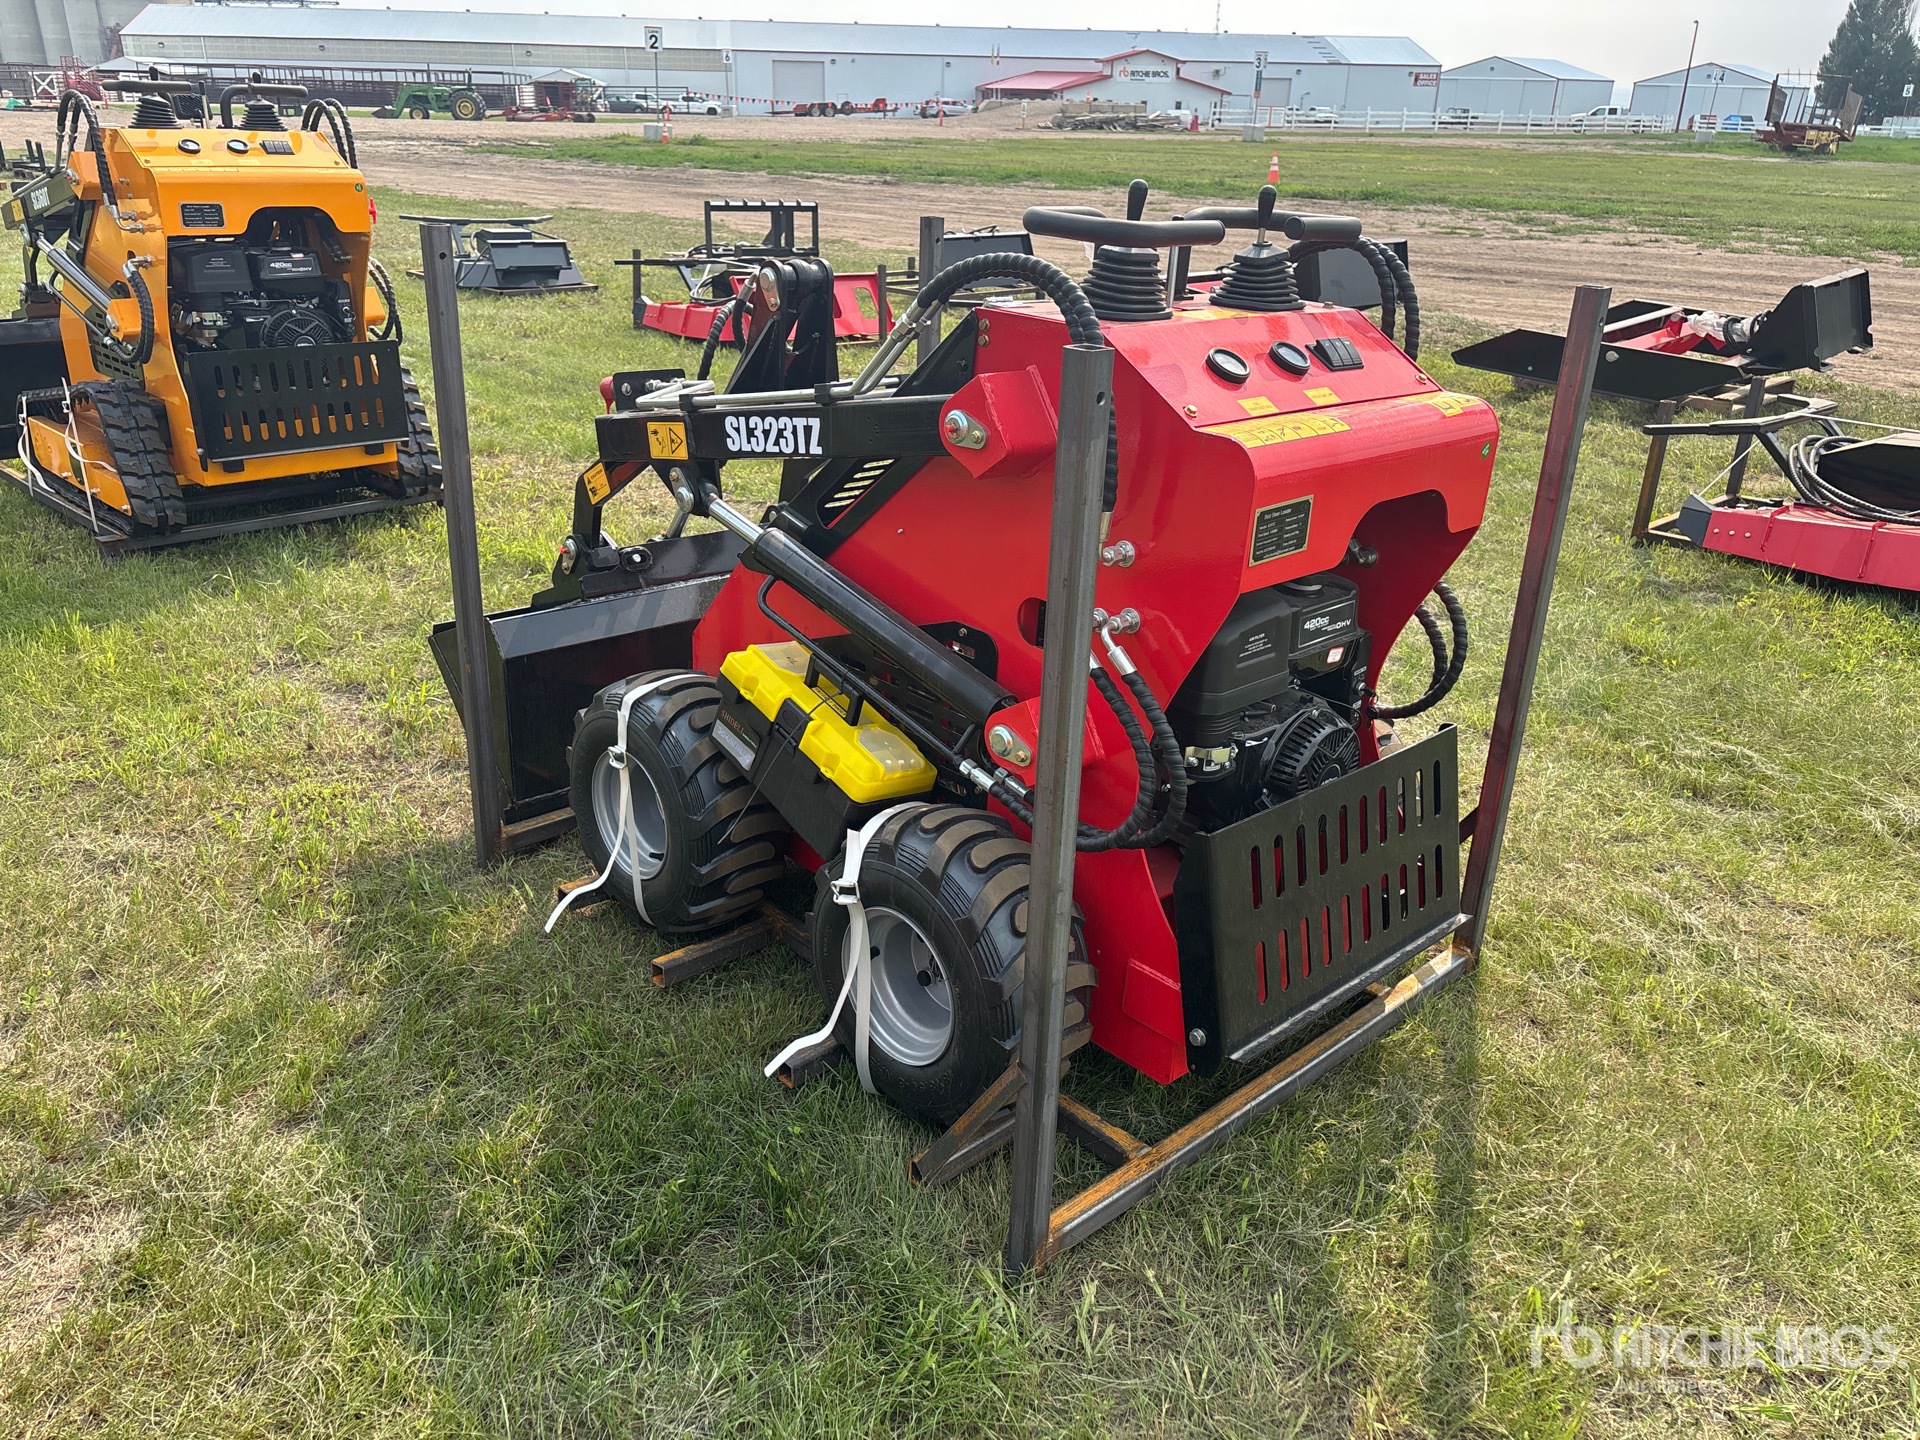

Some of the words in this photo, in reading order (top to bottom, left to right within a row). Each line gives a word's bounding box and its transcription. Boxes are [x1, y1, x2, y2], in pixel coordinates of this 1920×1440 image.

[649, 34, 658, 49] 2
[724, 53, 731, 62] 6
[1255, 57, 1261, 69] 3
[1130, 70, 1150, 78] RITCHIE
[1719, 72, 1725, 82] 4
[724, 415, 823, 455] SL323TZ
[1303, 616, 1330, 629] 420cc
